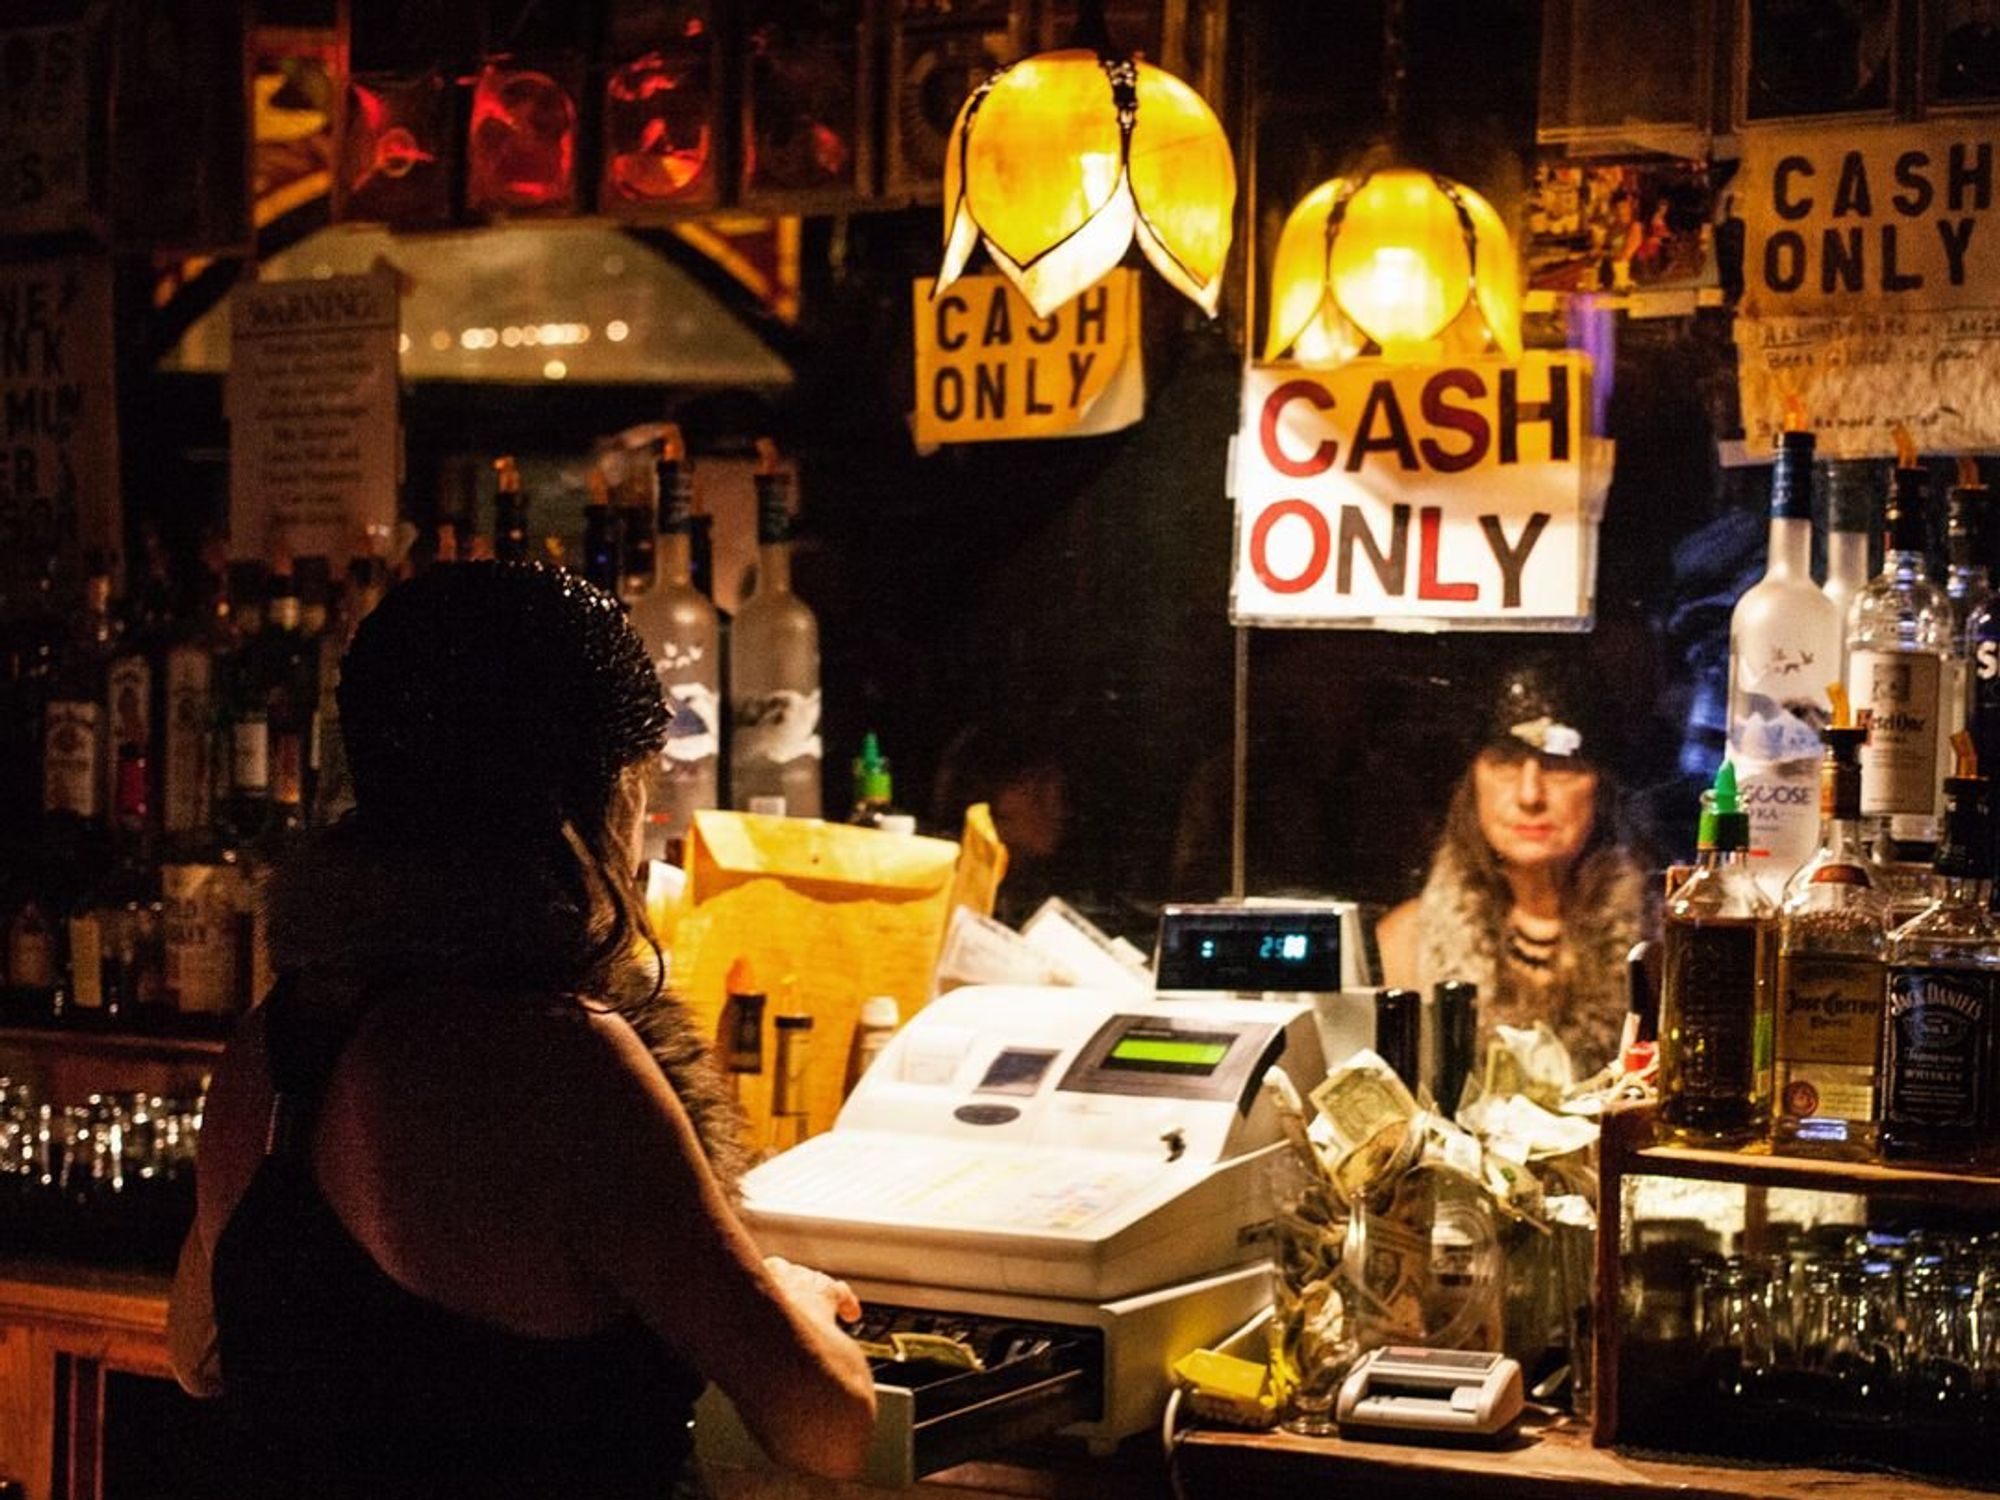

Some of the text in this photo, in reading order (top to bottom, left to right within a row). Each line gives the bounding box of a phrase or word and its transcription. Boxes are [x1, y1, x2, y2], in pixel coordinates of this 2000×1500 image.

[1773, 142, 1992, 220] CASH
[1764, 217, 1976, 293] ONLY
[933, 352, 1095, 422] ONLY
[1260, 365, 1570, 478] CASH
[1249, 498, 1551, 609] ONLY
